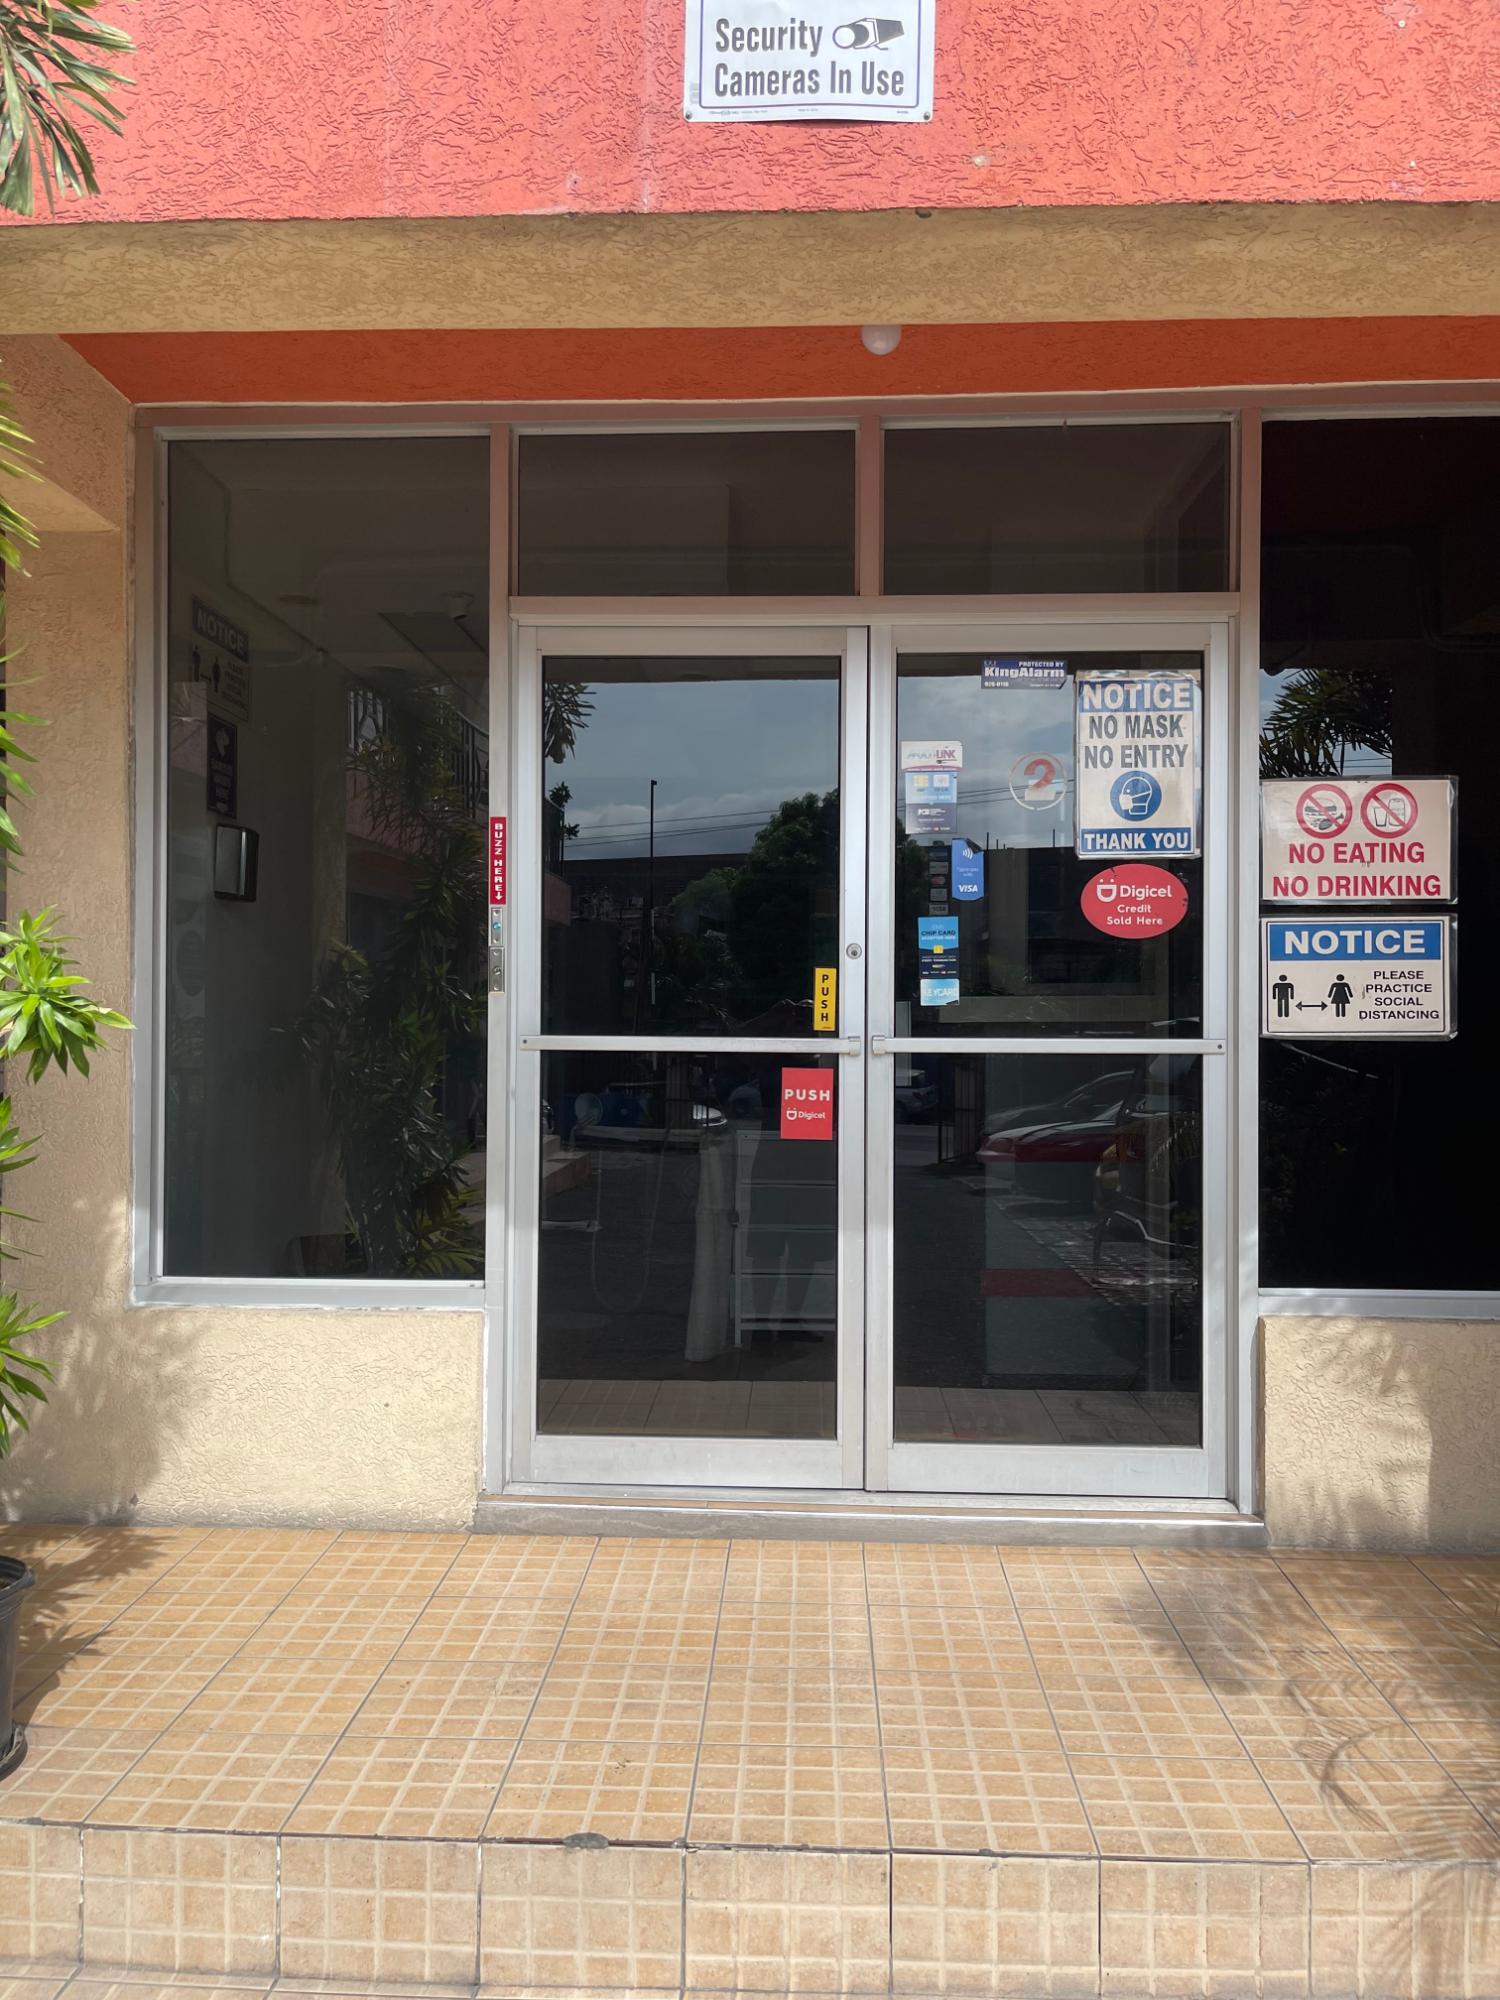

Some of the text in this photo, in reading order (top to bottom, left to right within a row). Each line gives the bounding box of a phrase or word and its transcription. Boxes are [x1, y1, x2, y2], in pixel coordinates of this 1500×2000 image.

[715, 17, 823, 57] Security
[714, 62, 820, 97] Cameras
[830, 60, 851, 94] In
[861, 60, 904, 96] Use
[196, 608, 245, 653] NOTICE
[984, 667, 1065, 679] KingAlarm
[1082, 682, 1191, 710] NOTICE
[1089, 714, 1184, 739] NO MASK
[1084, 744, 1189, 769] NO ENTRY
[1084, 831, 1189, 851] THANK YOU
[494, 823, 503, 891] BUZZ HERE
[1289, 842, 1425, 864] NO EATING
[958, 884, 978, 893] VISA
[1120, 884, 1172, 898] Digicel
[1273, 874, 1441, 897] NO DRINKING
[1117, 904, 1152, 913] Credit
[1107, 915, 1163, 925] Sold Here
[1285, 930, 1426, 954] NOTICE
[1373, 970, 1425, 980] PLEASE
[821, 974, 829, 1022] PUSH
[1366, 983, 1433, 993] PRACTICE
[1374, 997, 1424, 1006] SOCIAL
[1359, 1010, 1440, 1020] DISTANCING
[784, 1088, 830, 1101] PUSH
[798, 1110, 826, 1120] Digicel
